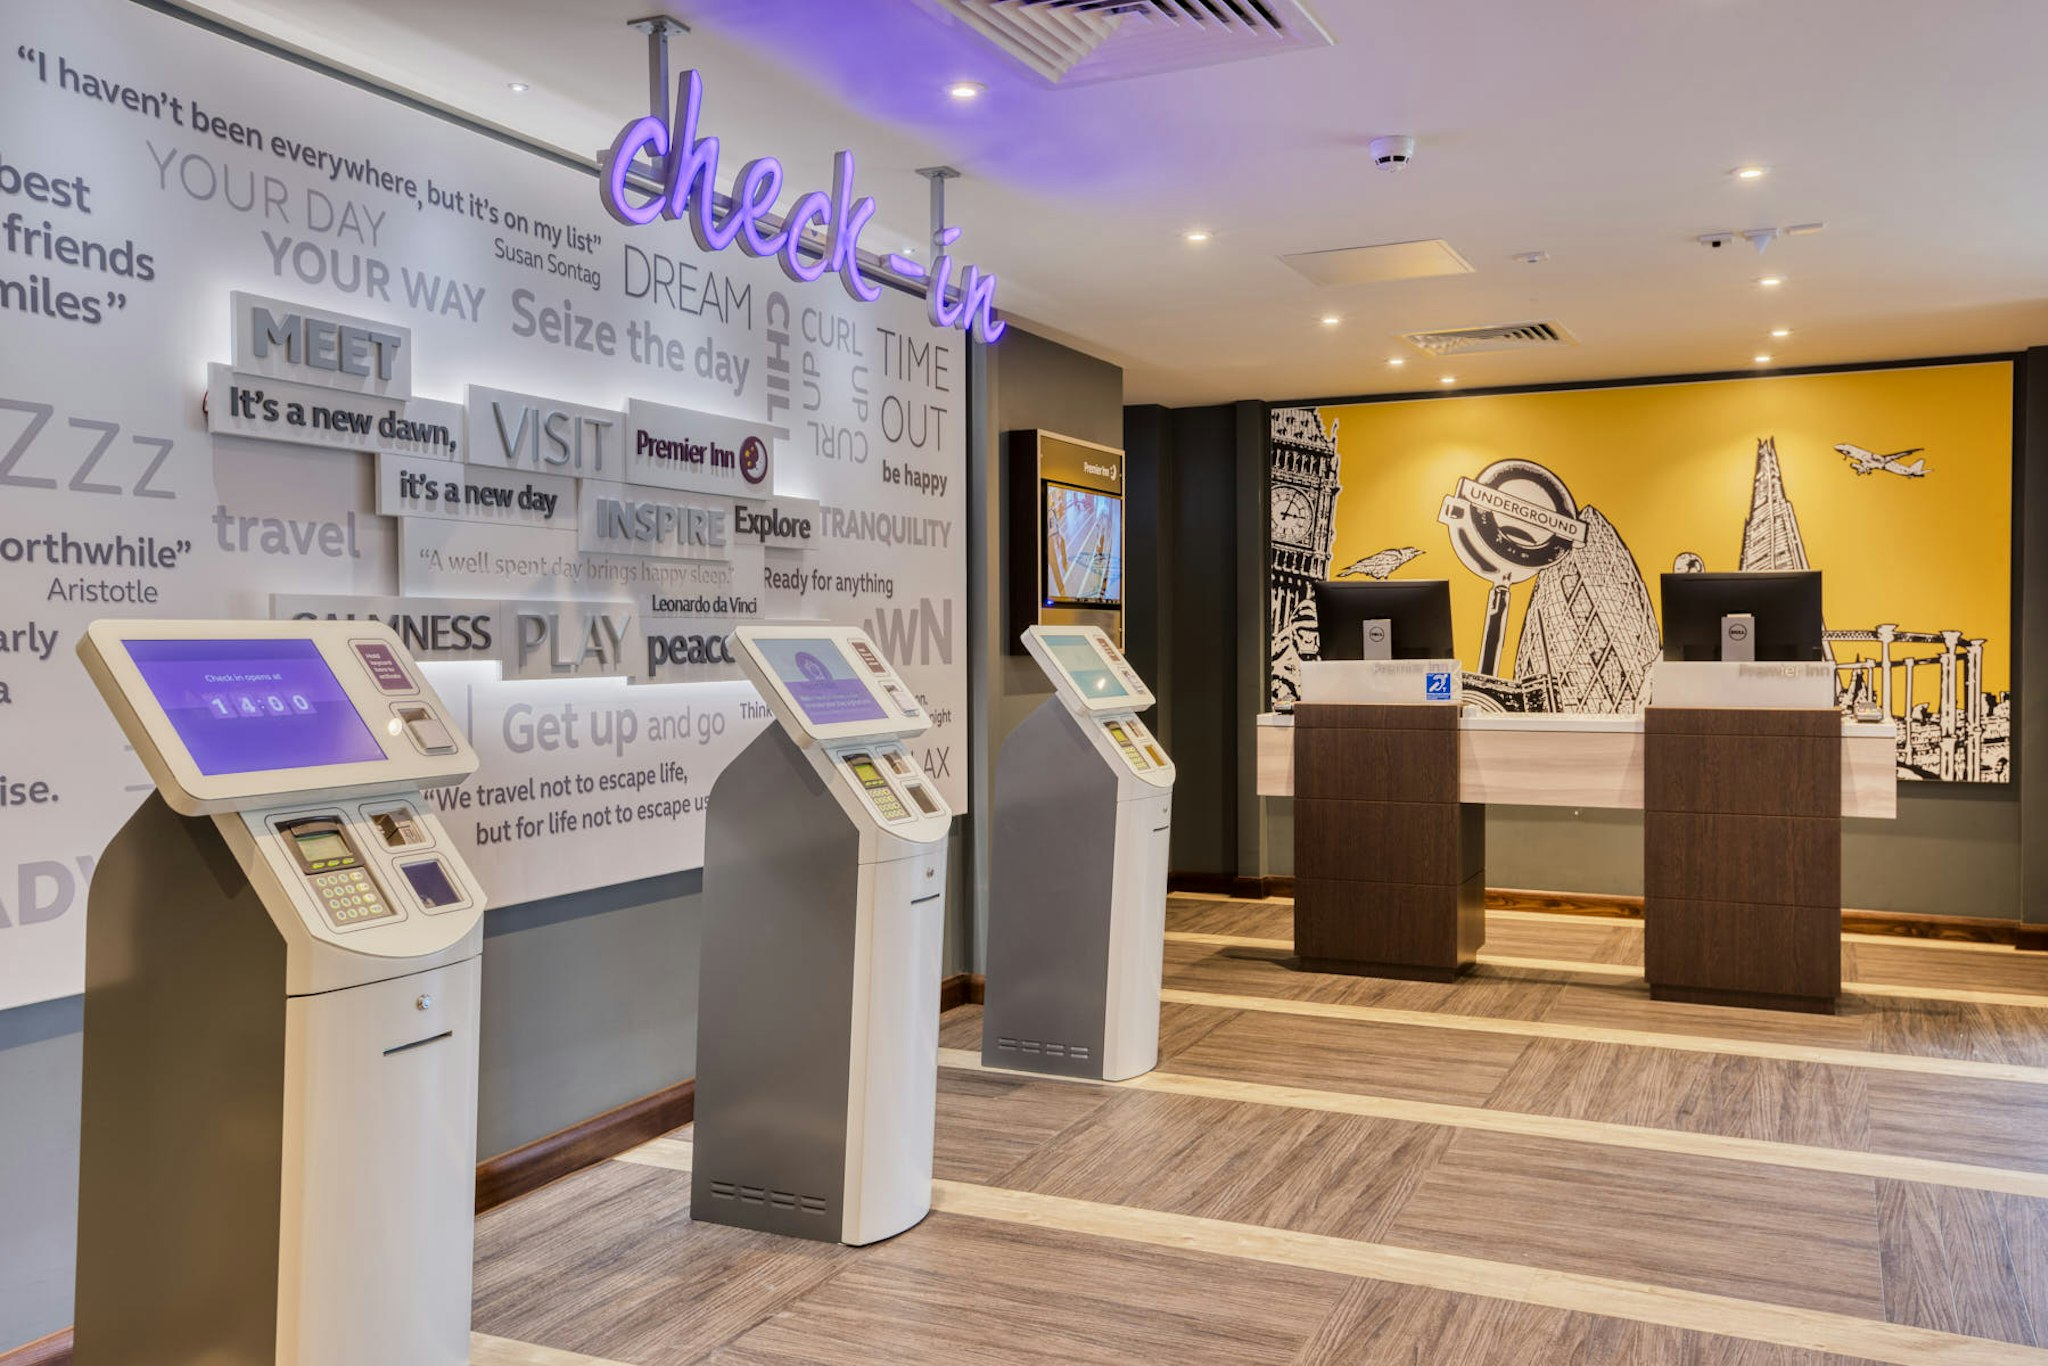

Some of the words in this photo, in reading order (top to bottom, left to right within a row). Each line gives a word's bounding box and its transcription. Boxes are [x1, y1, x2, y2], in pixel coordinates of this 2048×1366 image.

[59, 57, 183, 126] haven’t
[191, 105, 262, 150] been
[270, 134, 423, 211] everywhere,
[427, 179, 465, 214] but
[469, 193, 499, 225] it’s
[504, 209, 529, 234] on
[533, 219, 562, 248] my
[0, 153, 91, 214] best
[146, 139, 290, 224] YOUR
[306, 188, 387, 248] DAY
[600, 69, 1006, 344] check-in
[3, 212, 155, 281] friends
[494, 237, 544, 271] Susan
[547, 252, 602, 291] Sontag
[261, 230, 391, 302] YOUR
[401, 266, 487, 323] WAY
[623, 243, 752, 331] DREAM
[252, 306, 401, 381] MEET
[511, 287, 617, 356] Seize
[626, 319, 686, 373] the
[693, 336, 751, 397] day
[801, 306, 863, 357] CURL
[766, 290, 790, 441] CHILL
[803, 351, 821, 411] UP
[876, 327, 950, 392] TIME
[230, 385, 279, 421] It’s
[286, 402, 306, 427] a
[312, 403, 373, 435] new
[378, 410, 457, 452] dawn,
[852, 366, 868, 422] UP
[491, 401, 614, 472] VISIT
[636, 429, 708, 466] Premier
[710, 441, 736, 470] Inn
[807, 421, 868, 464] CURL
[880, 395, 948, 452] OUT
[400, 470, 438, 500] it’s
[444, 481, 461, 503] a
[464, 484, 513, 509] new
[518, 484, 558, 519] day
[882, 459, 901, 484] be
[904, 463, 948, 497] happy
[212, 504, 361, 559] travel
[596, 498, 728, 548] INSPIRE
[734, 504, 812, 543] Explore
[819, 505, 953, 549] TRANQUILITY
[1469, 486, 1578, 536] UNDERGROUND
[47, 577, 158, 603] Aristotle
[448, 551, 489, 575] well
[495, 556, 547, 579] spent
[551, 556, 583, 585] day
[586, 560, 638, 585] brings
[641, 563, 689, 587] happy
[764, 567, 808, 593] Ready
[812, 569, 835, 593] for
[836, 572, 894, 599] anything
[652, 595, 710, 615] Leonardo
[712, 596, 728, 615] da
[729, 596, 757, 615] Vinci
[293, 612, 492, 651] NESS
[517, 613, 631, 669] PLAY
[204, 674, 234, 682] Check
[245, 674, 271, 682] opens
[1373, 662, 1424, 675] Premier
[1739, 663, 1801, 678] Premier
[1805, 664, 1830, 677] Inn
[212, 694, 309, 714] 14:00
[502, 702, 579, 754] Get
[590, 706, 638, 757] up
[648, 706, 690, 741] and
[697, 711, 725, 745] go
[477, 778, 535, 807] travel
[540, 774, 571, 799] not
[575, 772, 594, 794] to
[599, 766, 656, 793] escape
[659, 761, 688, 785] life,
[476, 822, 511, 846] but
[516, 816, 545, 840] for
[549, 810, 577, 835] life
[582, 806, 611, 830] not
[615, 805, 633, 825] to
[637, 797, 691, 822] escape
